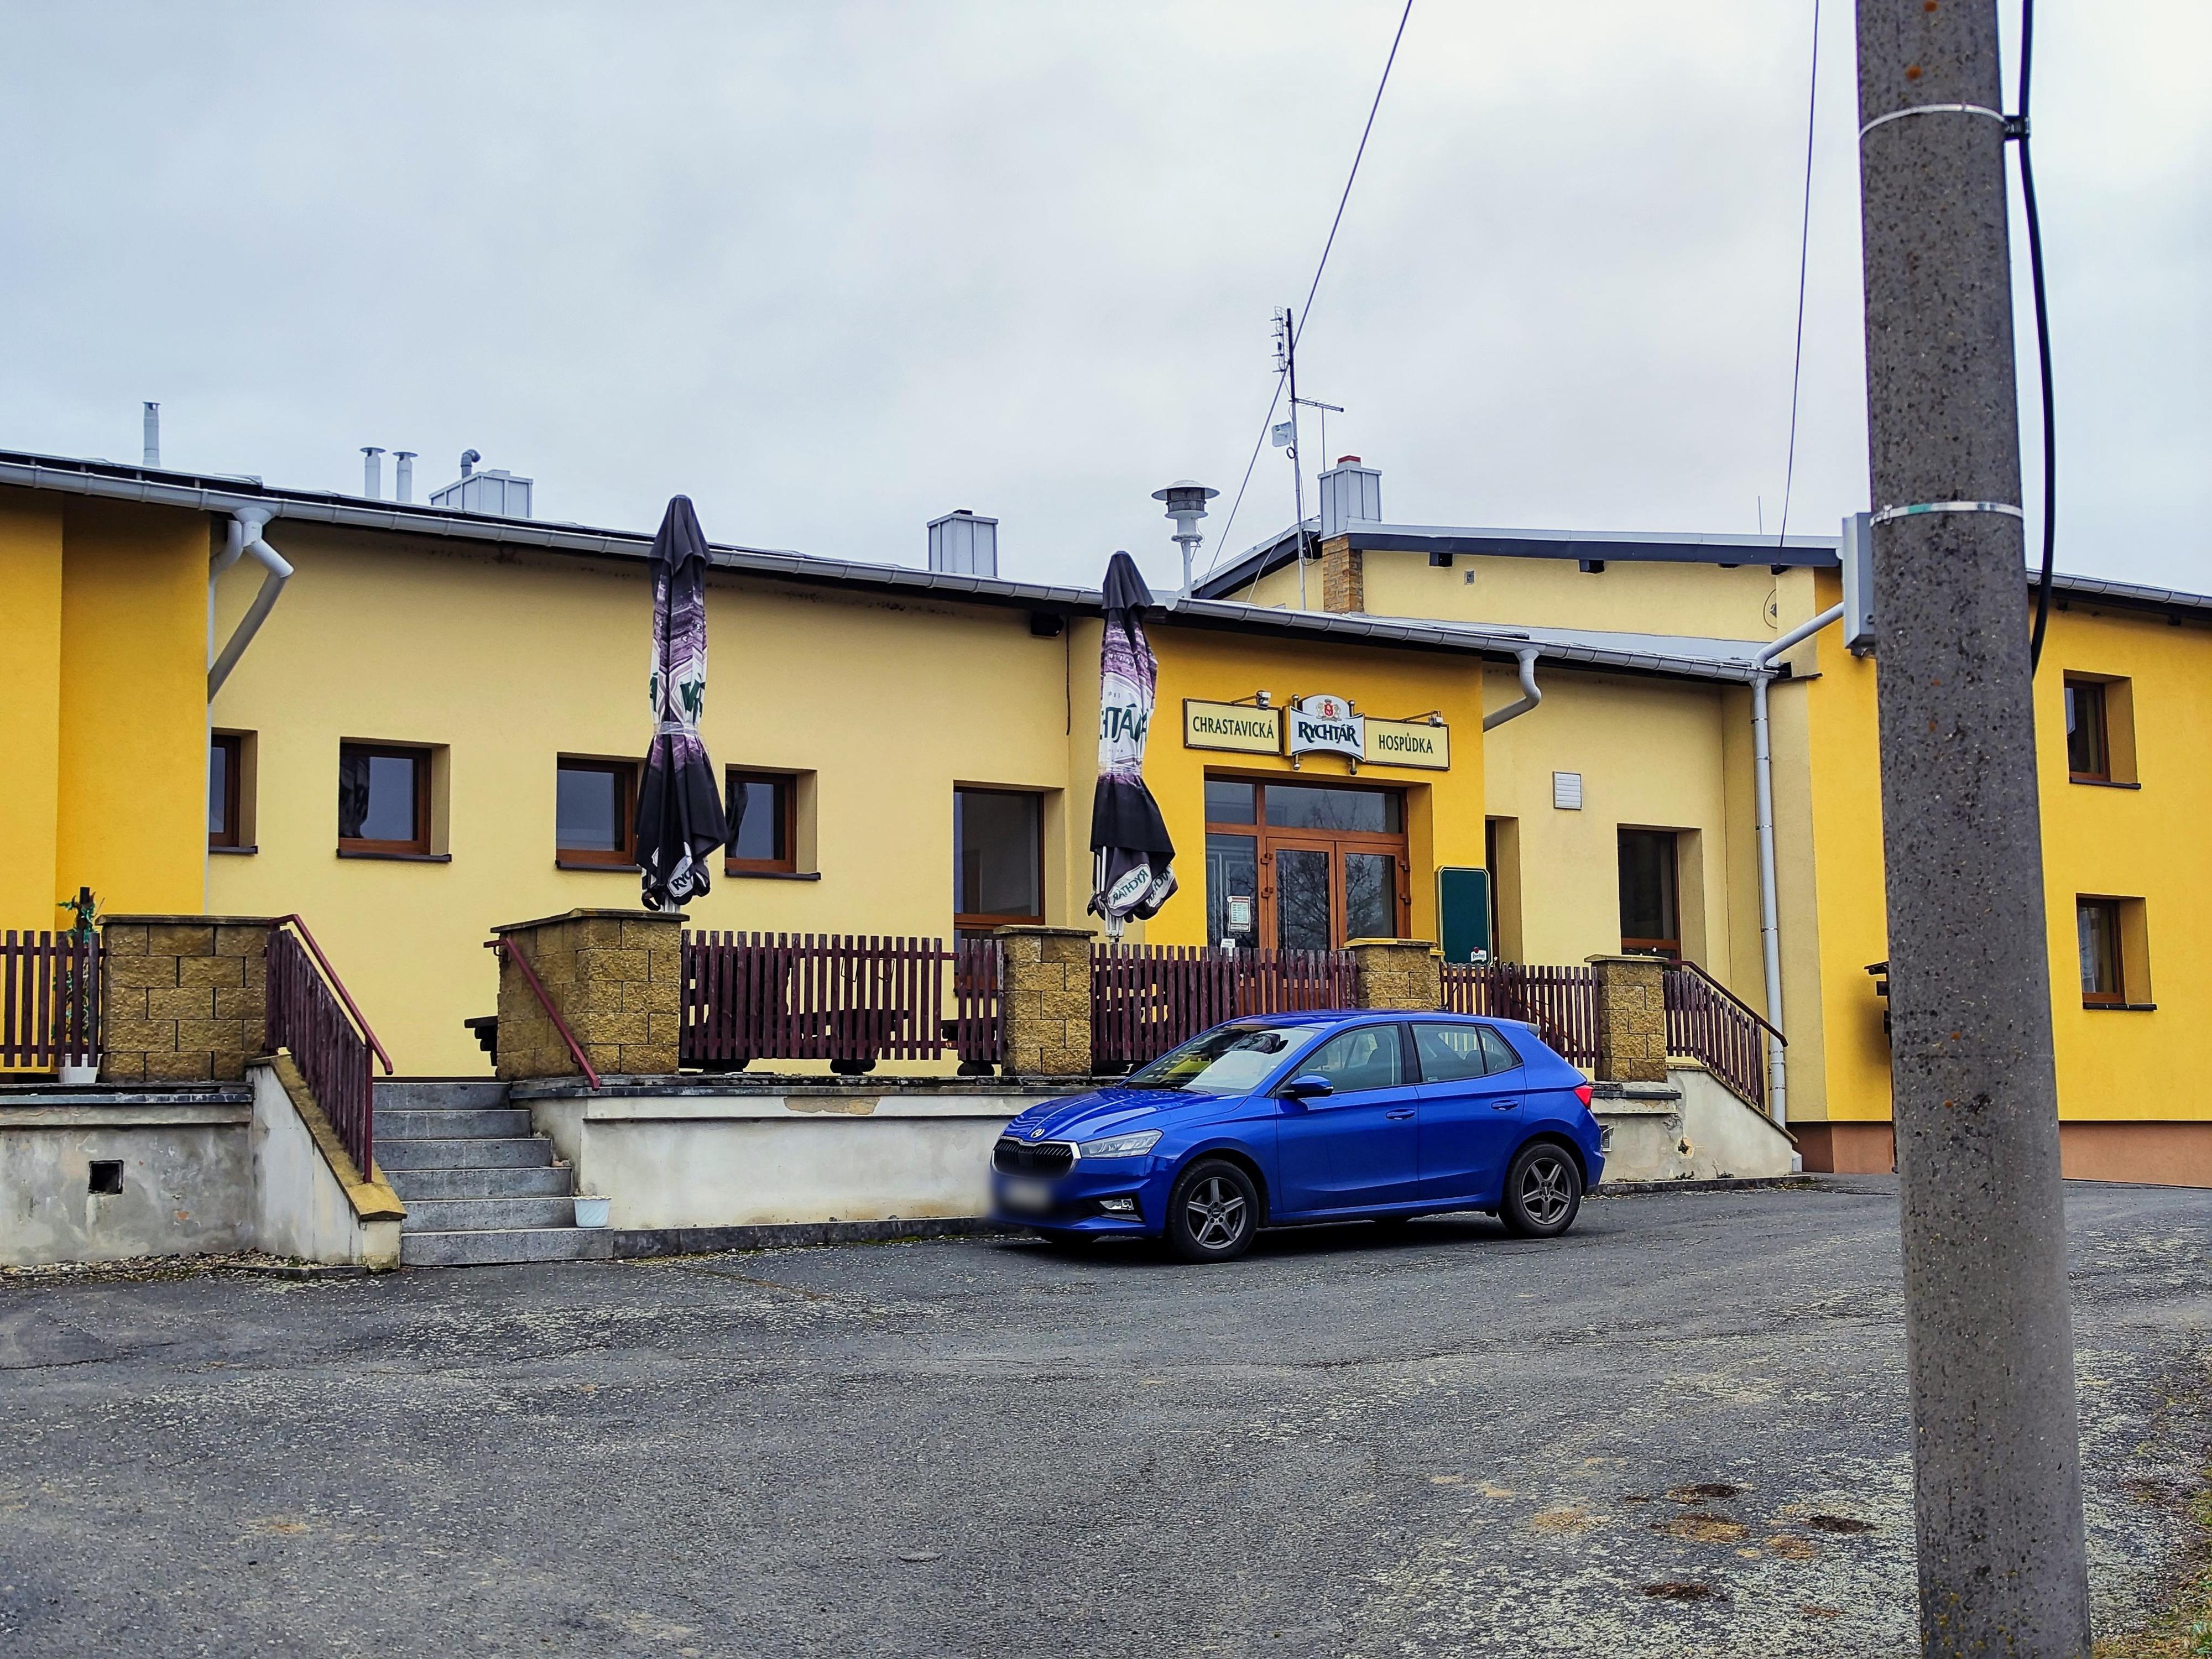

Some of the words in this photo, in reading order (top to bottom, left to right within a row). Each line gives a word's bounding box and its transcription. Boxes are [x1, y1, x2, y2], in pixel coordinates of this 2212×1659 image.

[1193, 716, 1274, 739] CHRASTAVICKÁ
[1298, 721, 1360, 747] RYCHTÁŘ
[1379, 732, 1433, 754] HOSPŮDKA
